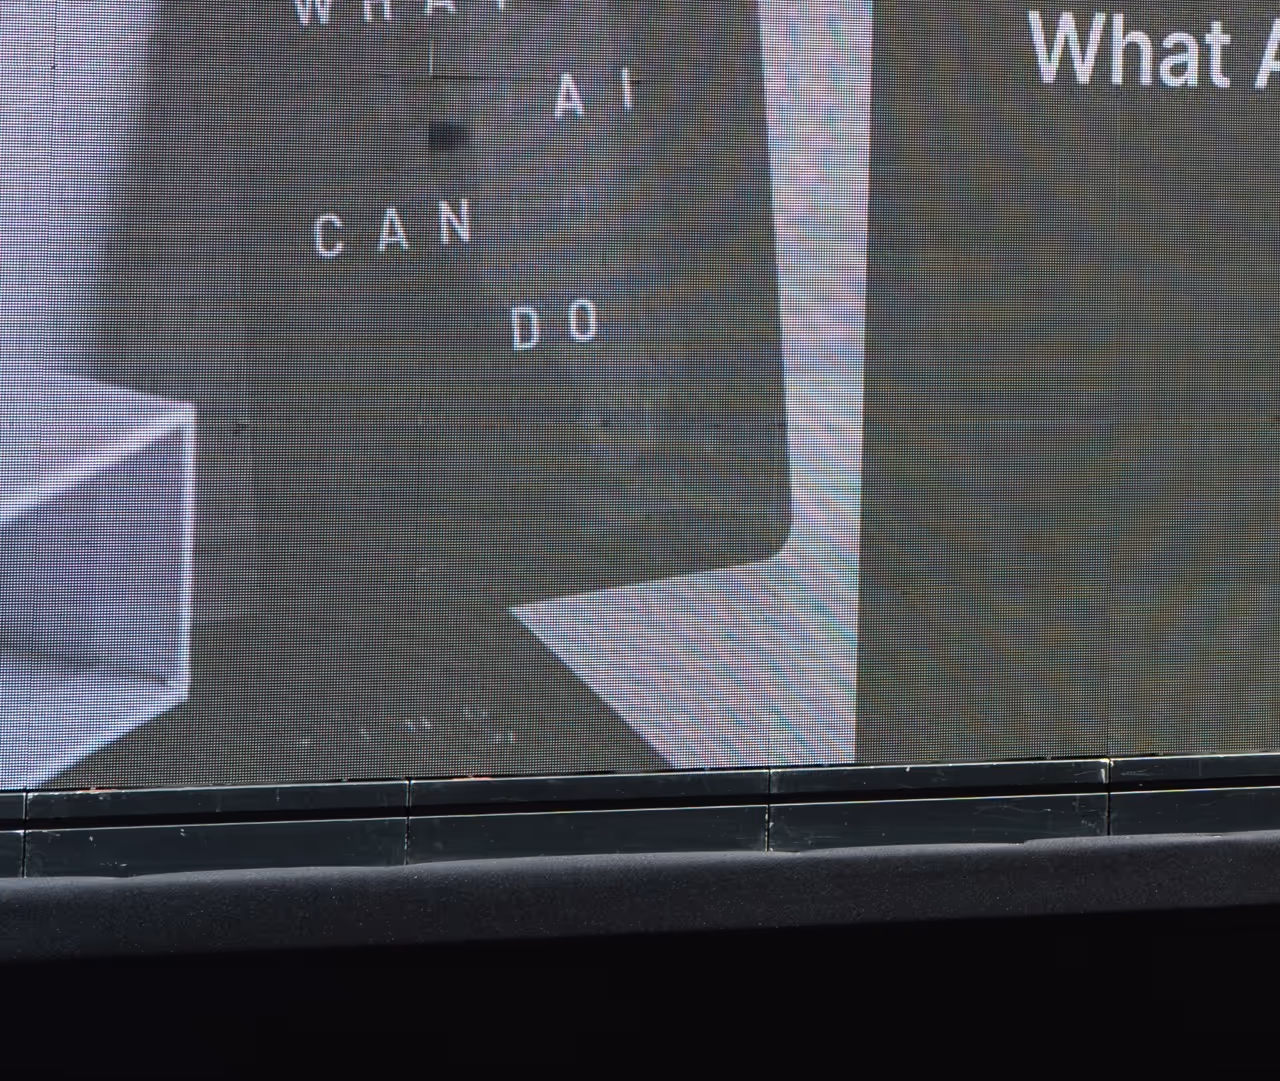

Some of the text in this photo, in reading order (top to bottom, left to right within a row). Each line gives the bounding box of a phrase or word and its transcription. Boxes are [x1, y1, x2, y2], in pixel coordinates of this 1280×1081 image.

[1027, 10, 1232, 90] What
[553, 67, 632, 118] AI
[313, 199, 473, 259] CAN
[511, 299, 598, 352] DO
